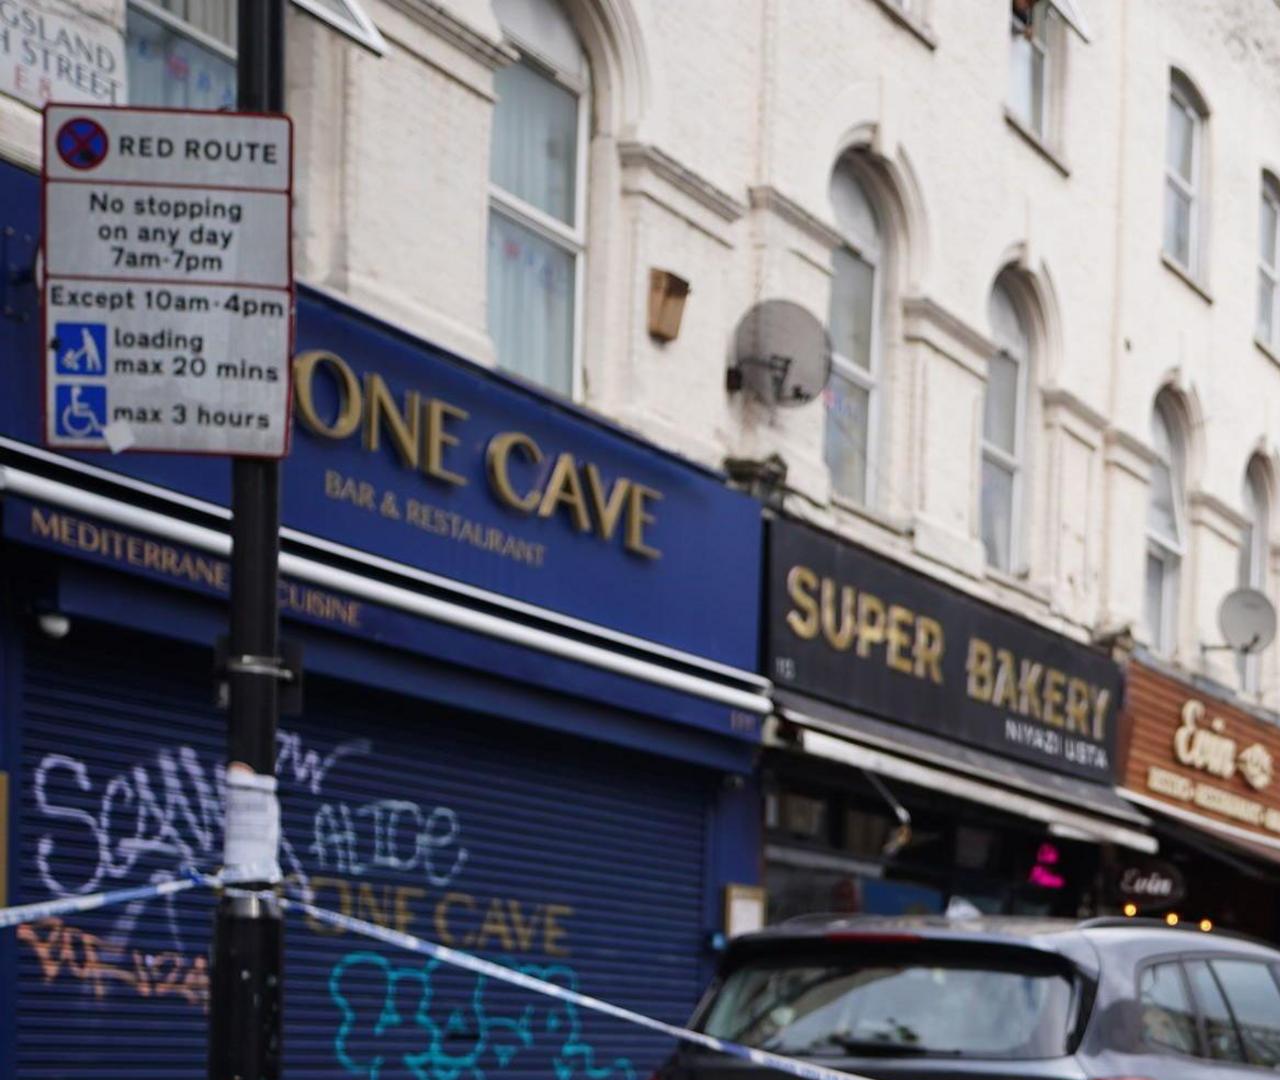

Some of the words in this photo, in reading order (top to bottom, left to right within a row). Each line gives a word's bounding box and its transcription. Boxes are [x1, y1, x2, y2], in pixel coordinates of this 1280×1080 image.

[118, 136, 174, 160] RED
[184, 139, 279, 165] ROUTE
[89, 193, 125, 215] No
[133, 196, 243, 224] stopping
[98, 226, 129, 242] on
[137, 226, 182, 248] any
[189, 224, 234, 250] day
[50, 286, 136, 314] Except
[113, 327, 205, 352] loading
[113, 359, 163, 377] max
[172, 358, 207, 377] 20
[216, 361, 280, 383] mins
[113, 405, 162, 424] max
[171, 405, 188, 425] 3
[199, 401, 271, 430] hours
[486, 431, 664, 561] CAVE
[324, 468, 376, 512] BAR
[406, 497, 547, 568] RESTAURANT
[31, 506, 231, 592] MEDITERRANE
[786, 564, 946, 685] SUPER
[966, 634, 1110, 740] BAKERY
[433, 892, 576, 954] CAVE
